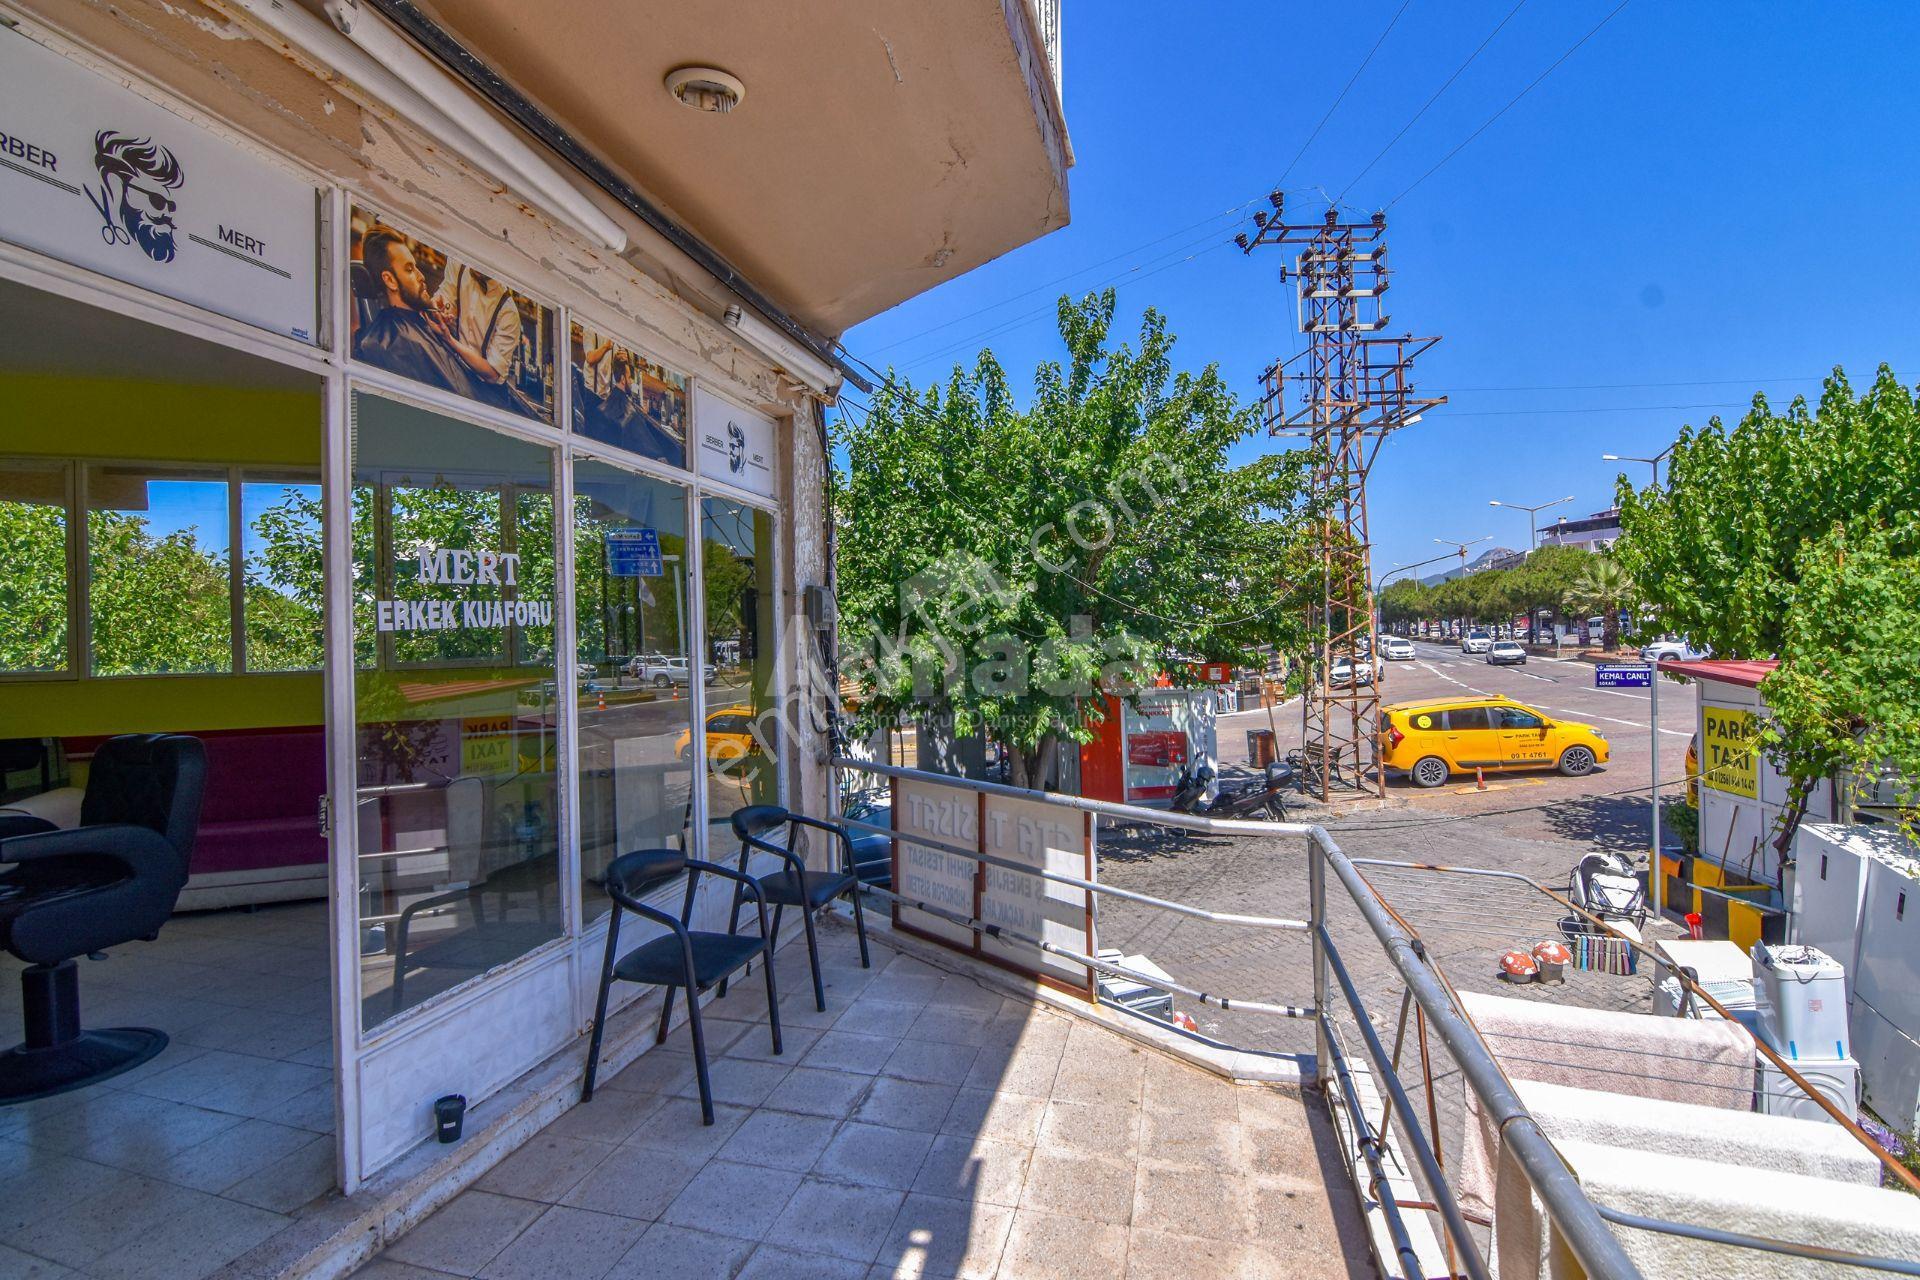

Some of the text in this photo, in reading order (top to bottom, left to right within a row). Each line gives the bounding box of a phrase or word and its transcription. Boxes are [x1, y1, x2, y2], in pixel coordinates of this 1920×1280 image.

[218, 224, 266, 257] MERT
[705, 434, 724, 448] BERBER
[752, 453, 764, 464] MERT
[417, 547, 521, 586] MERT
[377, 594, 552, 632] ERKEK KUAFÖRÜ
[1599, 672, 1649, 680] KEMAL CANLI
[1706, 717, 1751, 742] PARK
[1711, 744, 1750, 770] TAXI
